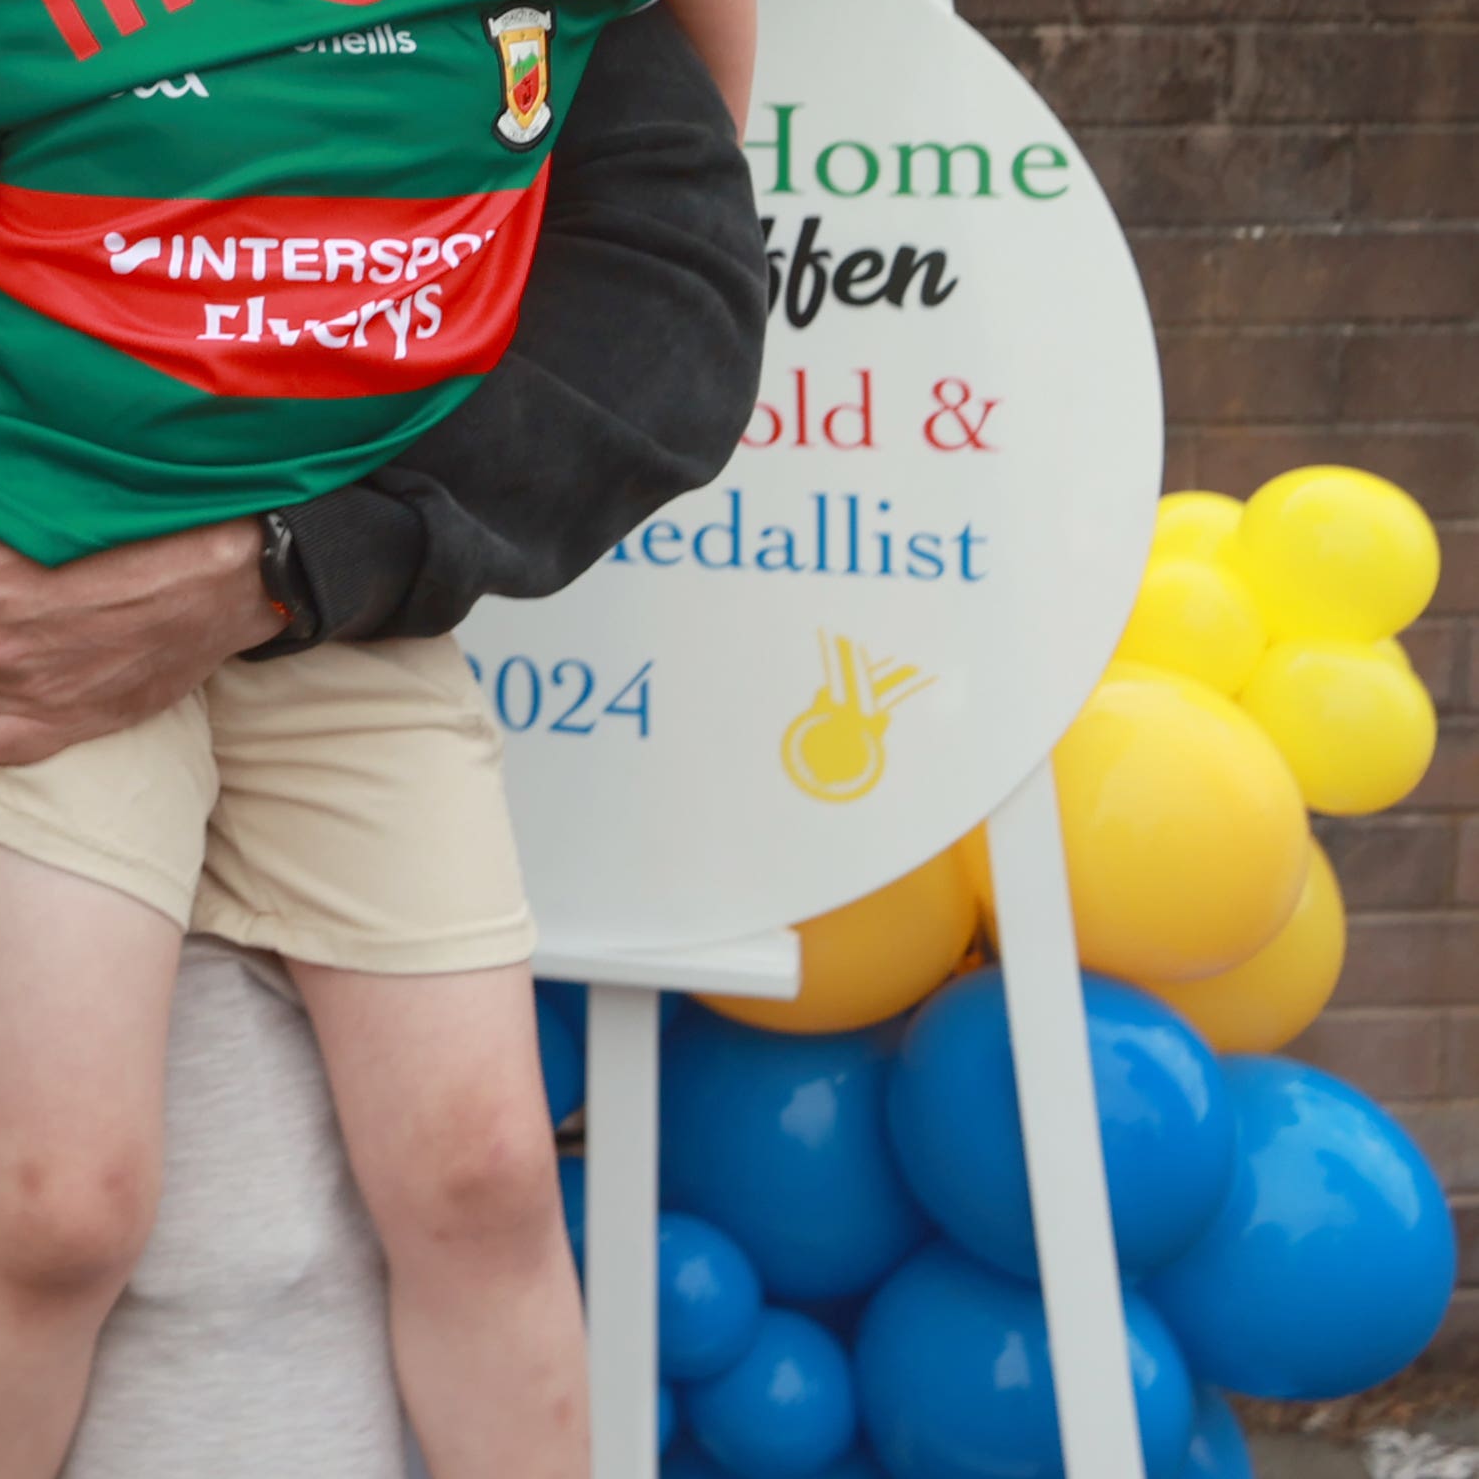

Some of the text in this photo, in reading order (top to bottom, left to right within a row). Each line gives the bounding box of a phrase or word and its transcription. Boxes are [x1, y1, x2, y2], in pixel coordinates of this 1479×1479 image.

[167, 229, 495, 284] INTERSPO
[923, 377, 1001, 453] &
[607, 489, 990, 582] edallist
[464, 653, 655, 738] 024
